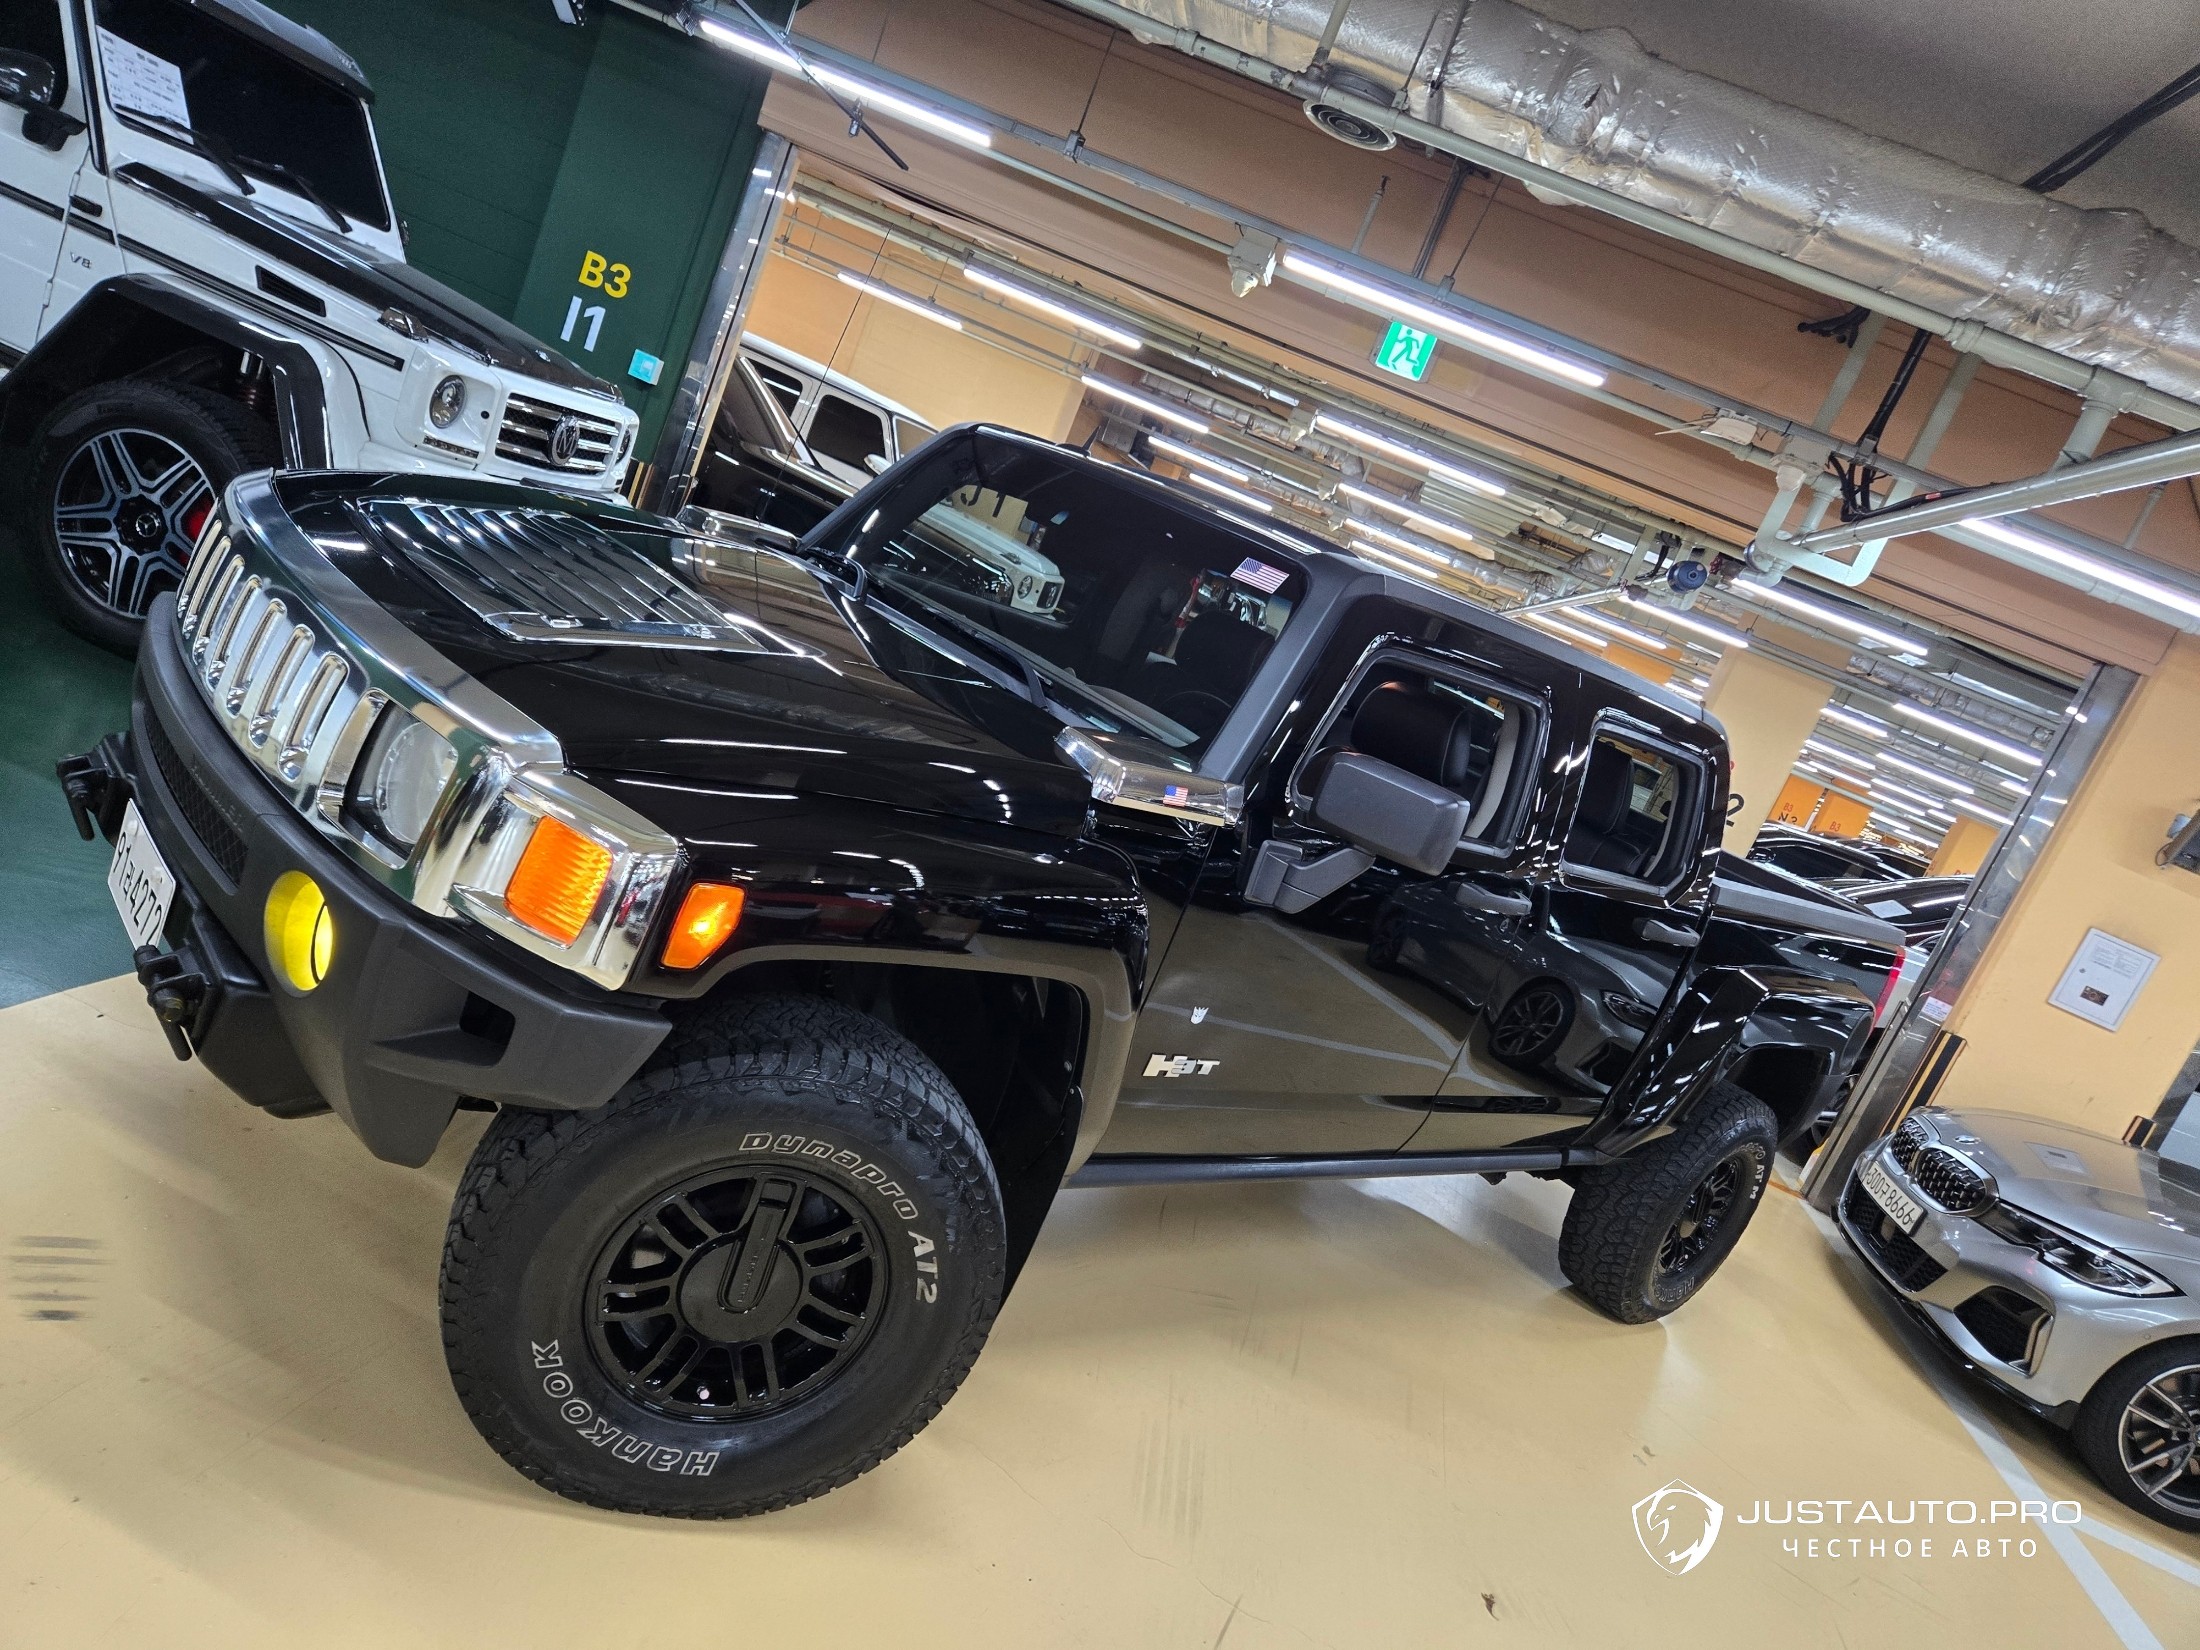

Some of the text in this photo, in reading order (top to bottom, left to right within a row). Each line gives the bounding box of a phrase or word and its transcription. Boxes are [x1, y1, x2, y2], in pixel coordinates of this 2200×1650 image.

[70, 251, 92, 269] V8
[578, 250, 631, 298] B3
[1829, 821, 1841, 832] B3
[1142, 1053, 1221, 1078] H3T
[1884, 1189, 1915, 1225] 8666
[907, 1230, 939, 1304] AT2
